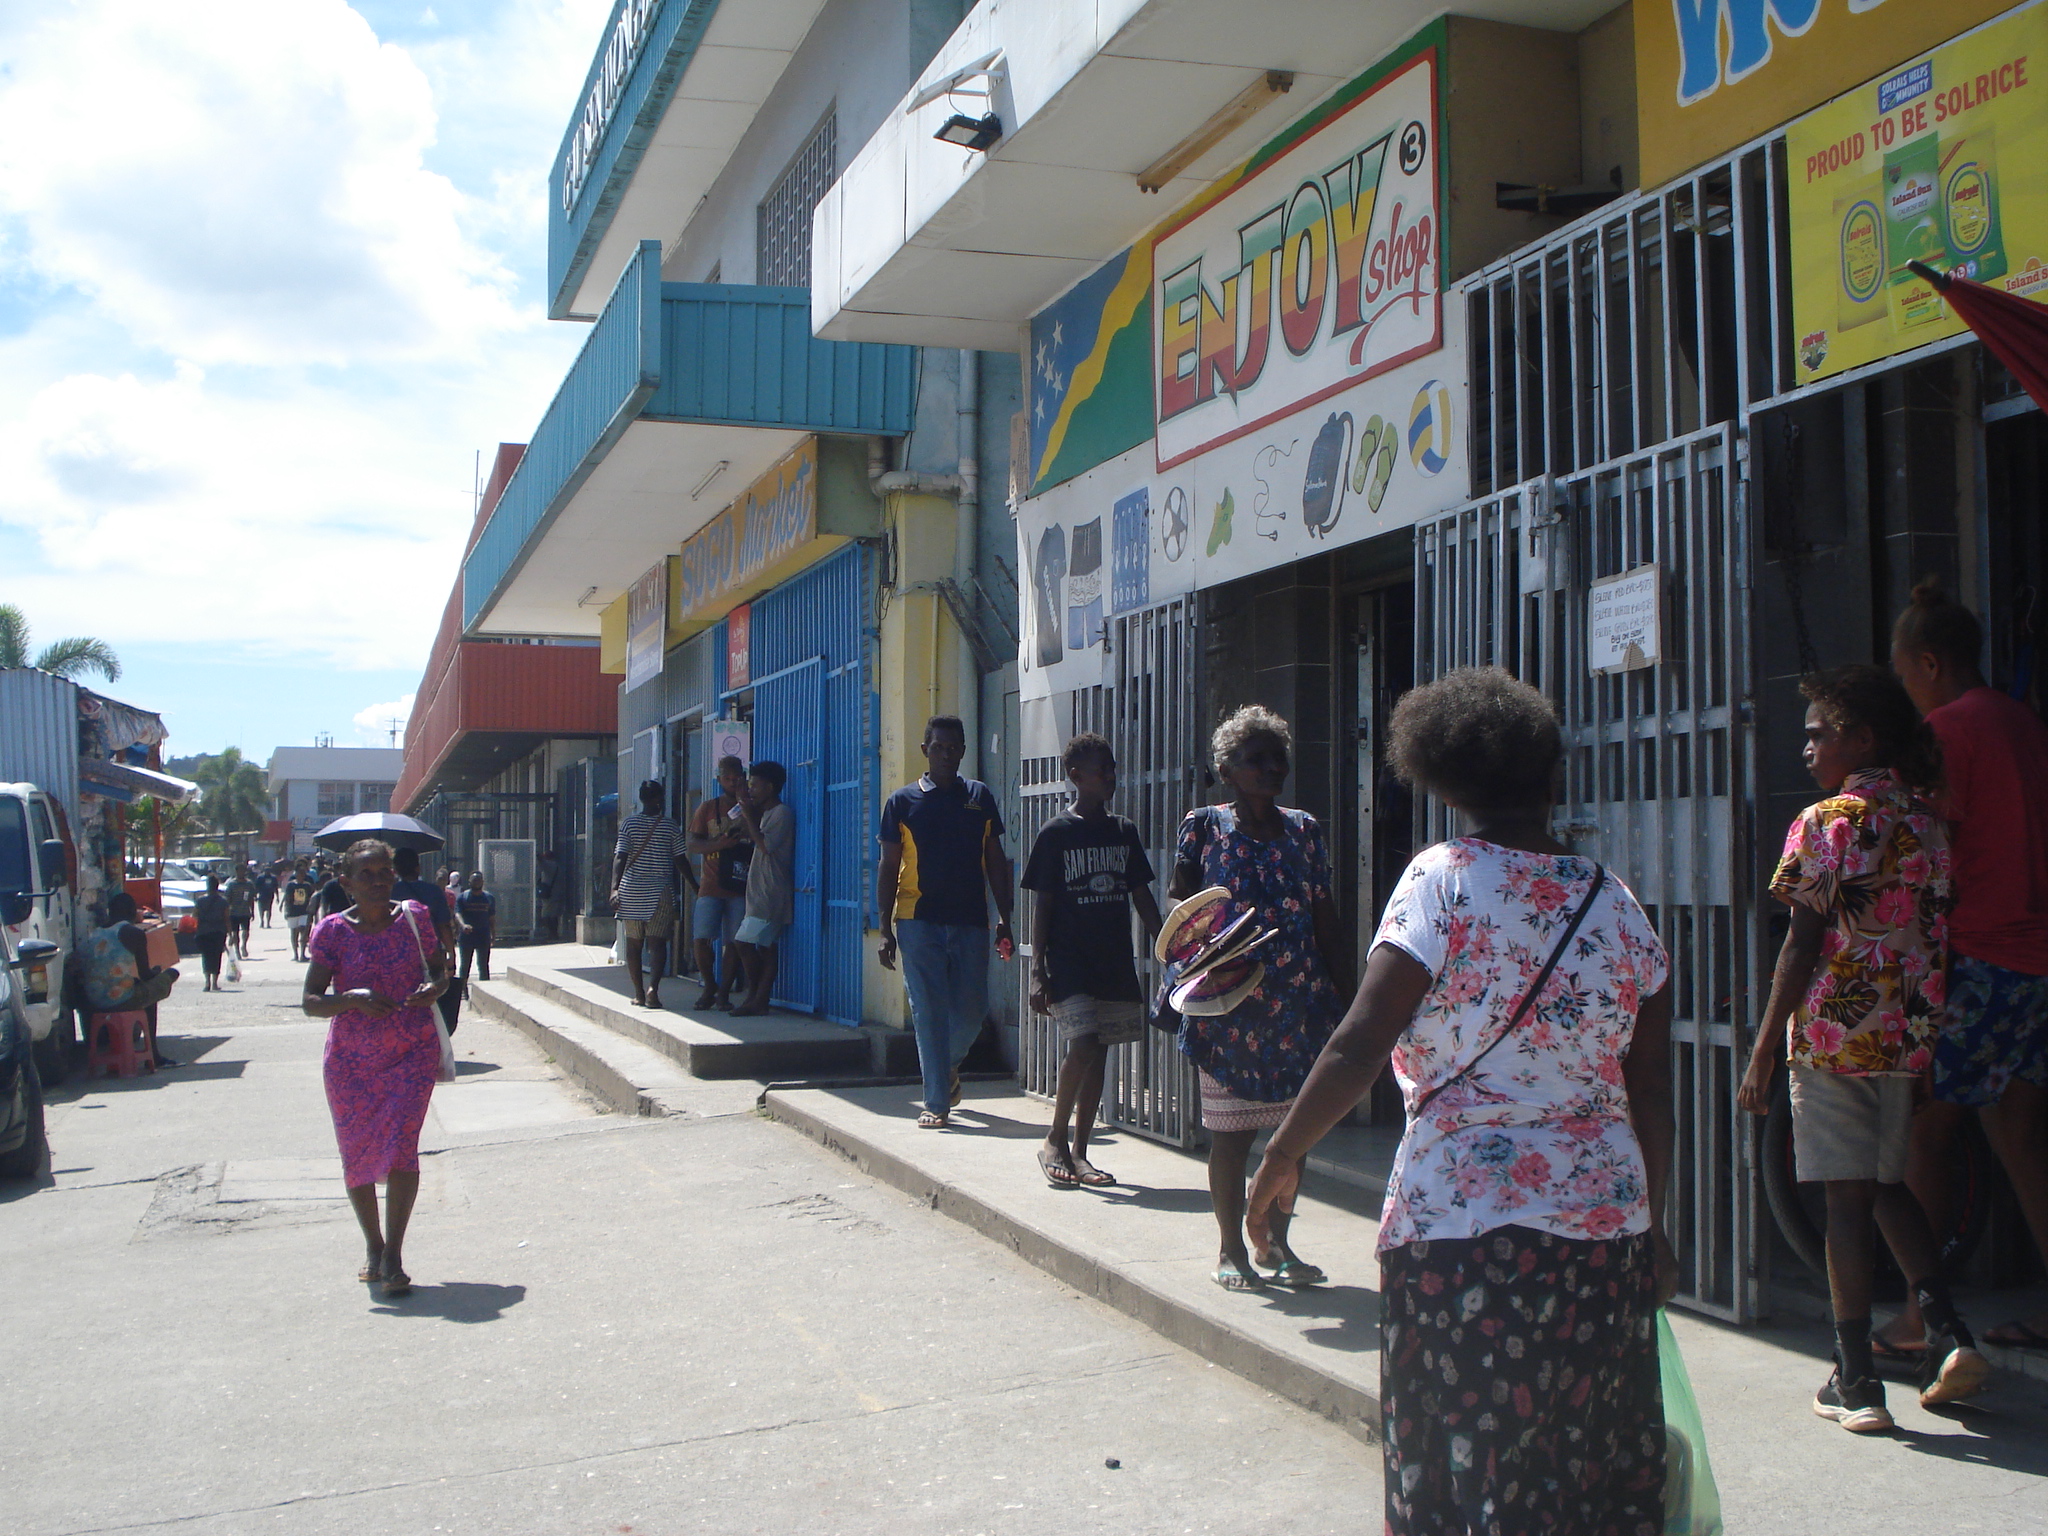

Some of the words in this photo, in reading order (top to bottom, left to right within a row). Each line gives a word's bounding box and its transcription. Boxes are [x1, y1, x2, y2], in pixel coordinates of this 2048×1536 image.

[1881, 73, 1908, 96] SOLRAIS
[1908, 64, 1929, 83] HELPS
[1881, 77, 1930, 109] CMMUNITY
[1807, 132, 1865, 184] PROUD
[1870, 117, 1895, 152] TO
[1901, 101, 1928, 138] BE
[1935, 56, 2028, 122] SOLRICE
[1892, 188, 1917, 206] Island
[1365, 202, 1432, 316] shop
[1159, 129, 1397, 425] ENJOY
[2005, 270, 2041, 291] Island
[738, 453, 814, 583] Market
[1063, 848, 1086, 883] SAN
